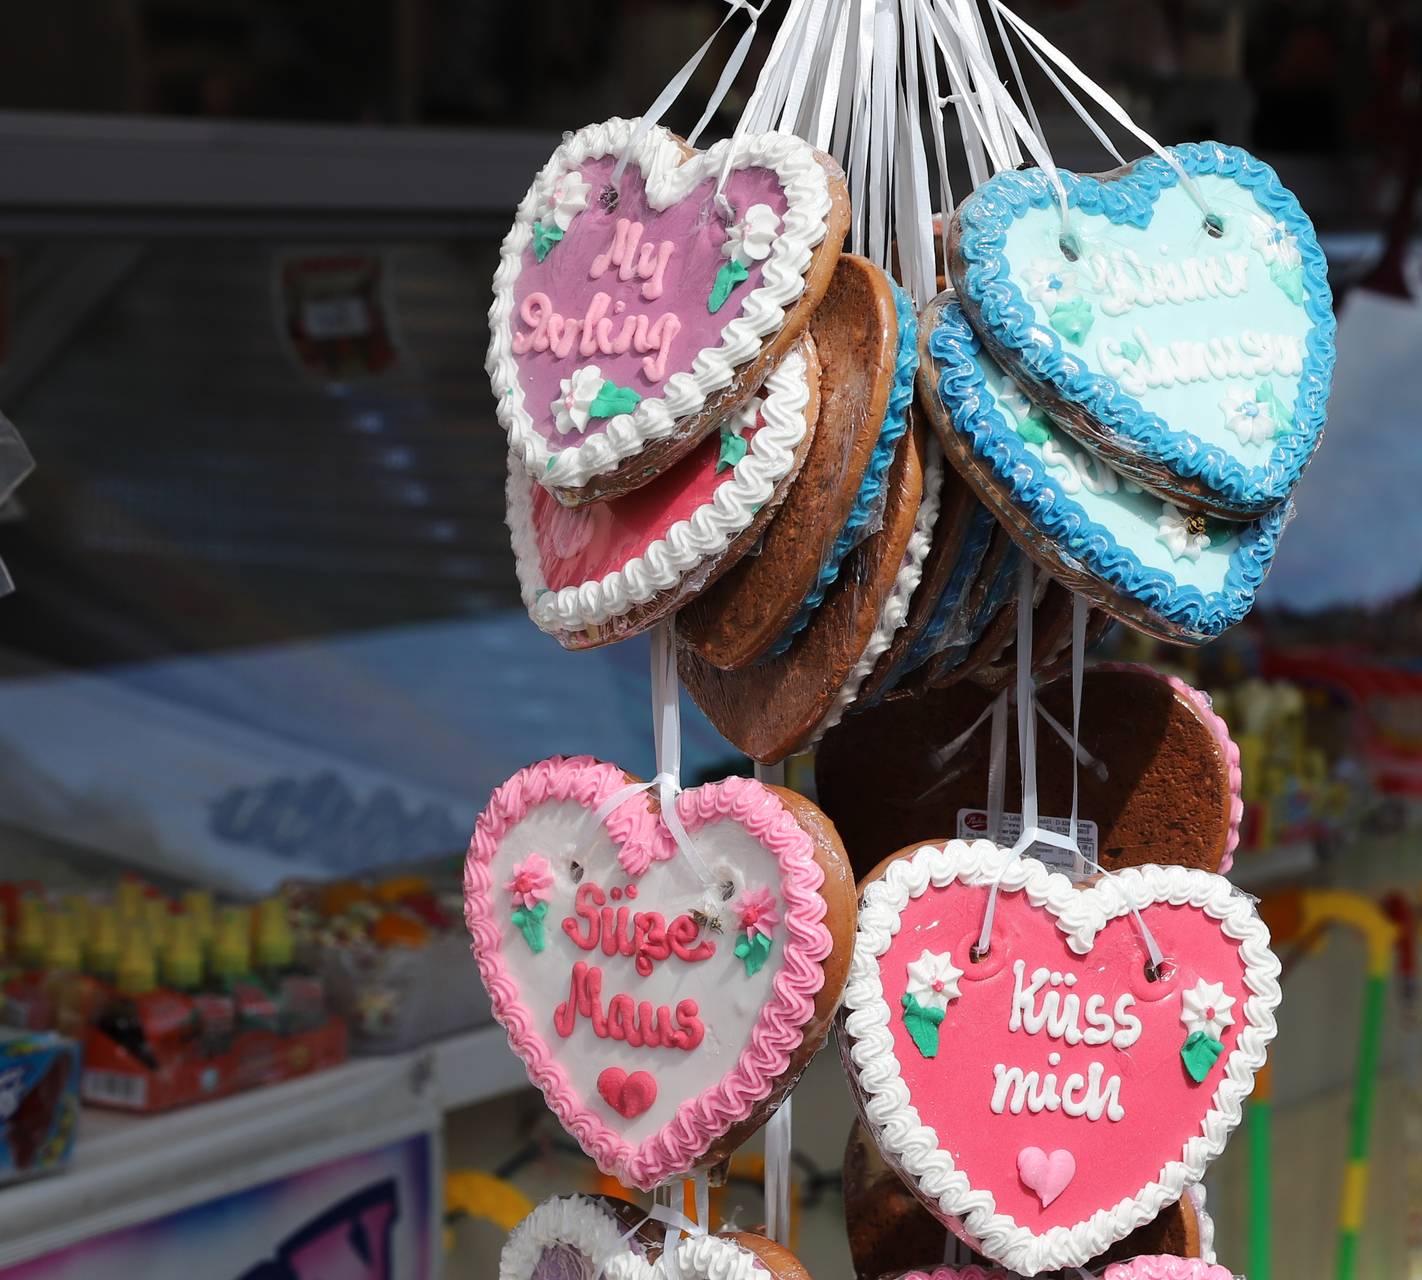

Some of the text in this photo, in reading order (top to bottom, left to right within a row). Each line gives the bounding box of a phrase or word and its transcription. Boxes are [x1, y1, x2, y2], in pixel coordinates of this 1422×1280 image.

[590, 217, 675, 301] My
[512, 291, 682, 383] Darling
[561, 882, 717, 977] Süße
[554, 961, 706, 1052] Maus
[1009, 958, 1143, 1049] Küss
[990, 1052, 1125, 1122] mich
